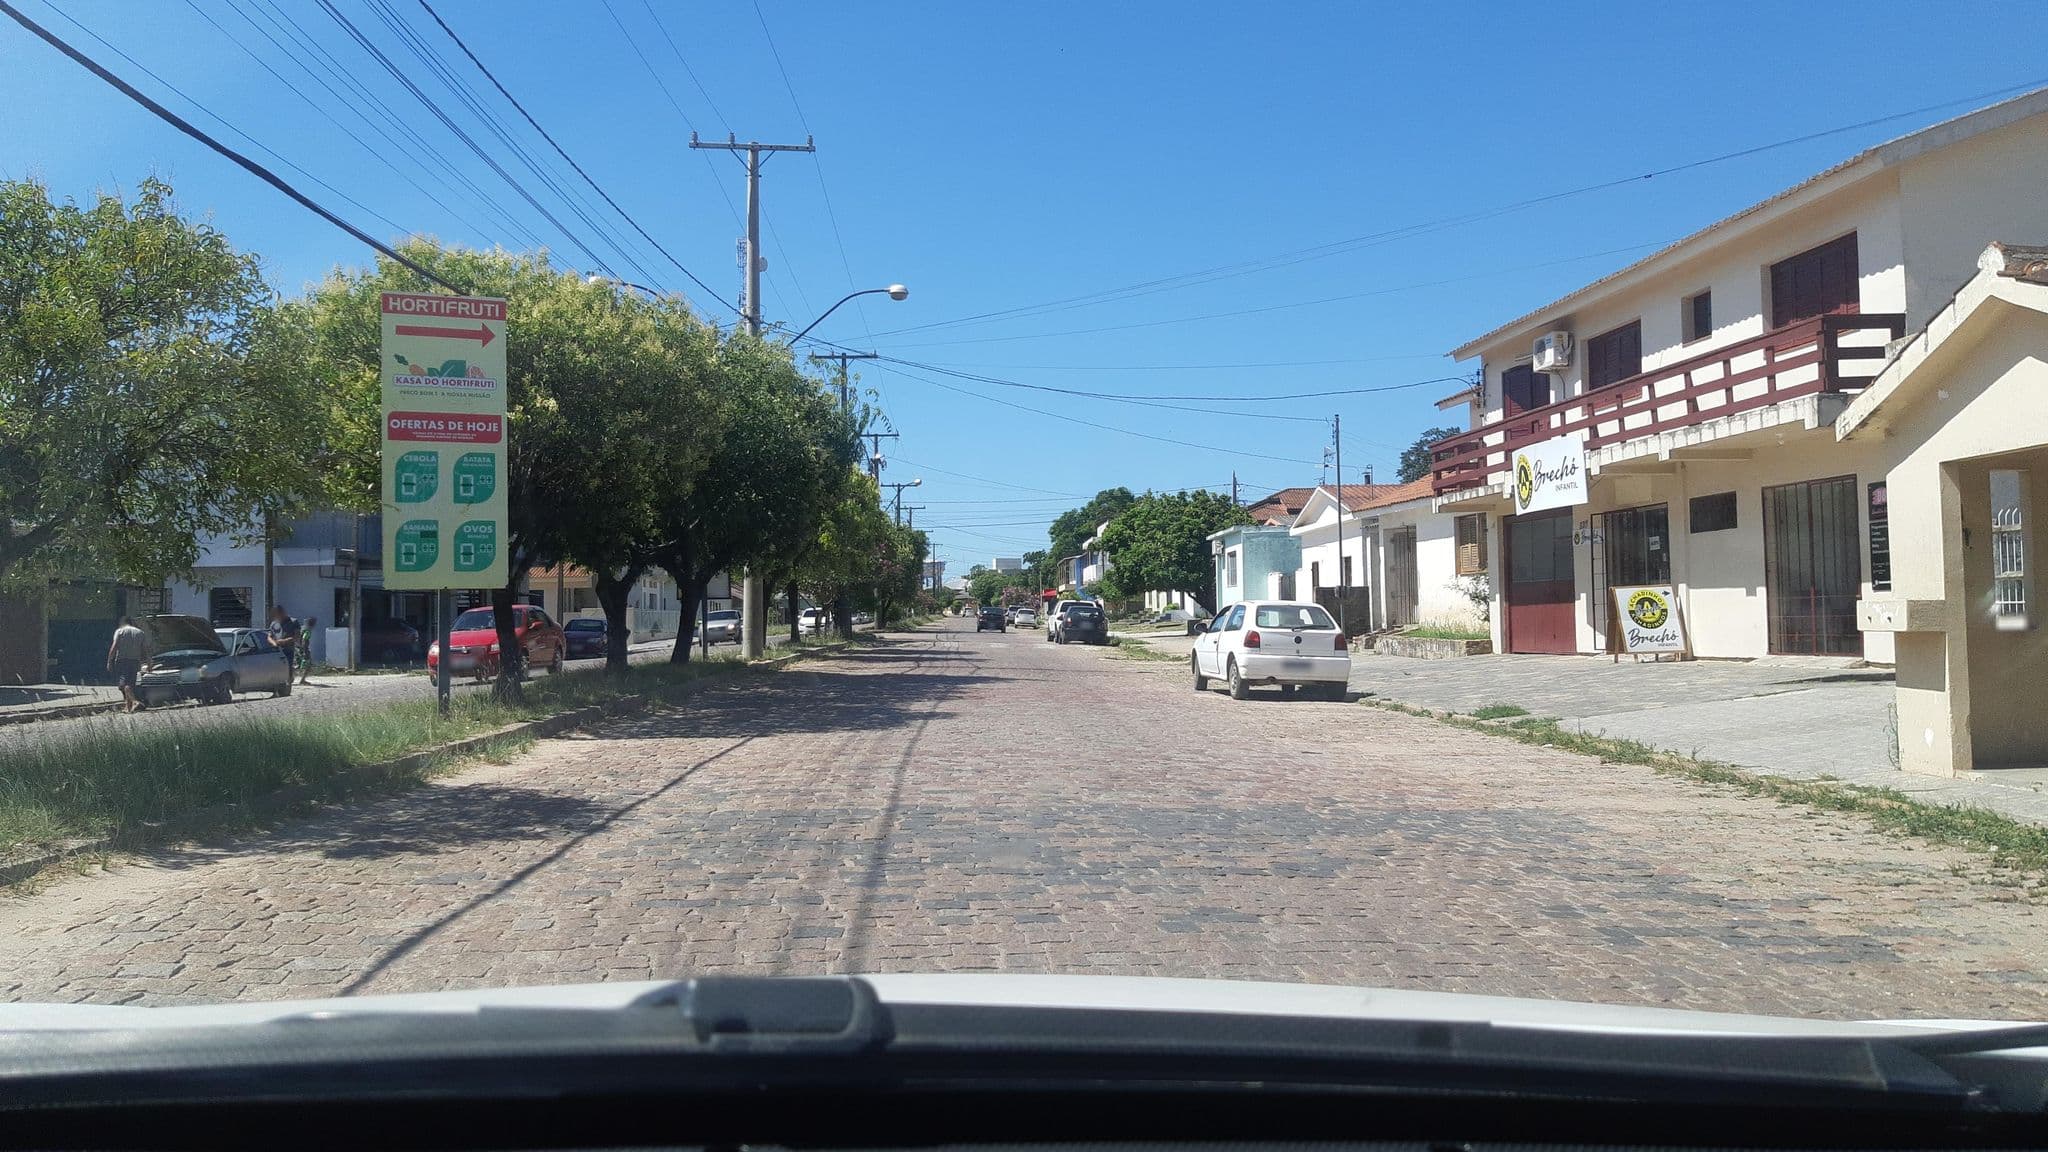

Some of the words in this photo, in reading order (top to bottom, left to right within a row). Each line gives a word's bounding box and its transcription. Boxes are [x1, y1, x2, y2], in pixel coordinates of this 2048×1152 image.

[388, 297, 500, 317] HORTIFRUTI
[395, 376, 421, 385] KASA
[424, 377, 439, 386] DO
[441, 378, 495, 389] HORTIFRUTI
[390, 419, 444, 430] OFERTAS
[448, 421, 464, 431] DE
[467, 422, 499, 432] HOJE
[403, 454, 437, 462] CEBOLA
[1533, 455, 1579, 492] Brechó
[463, 525, 494, 533] OVOS
[1628, 628, 1679, 648] Brechó
